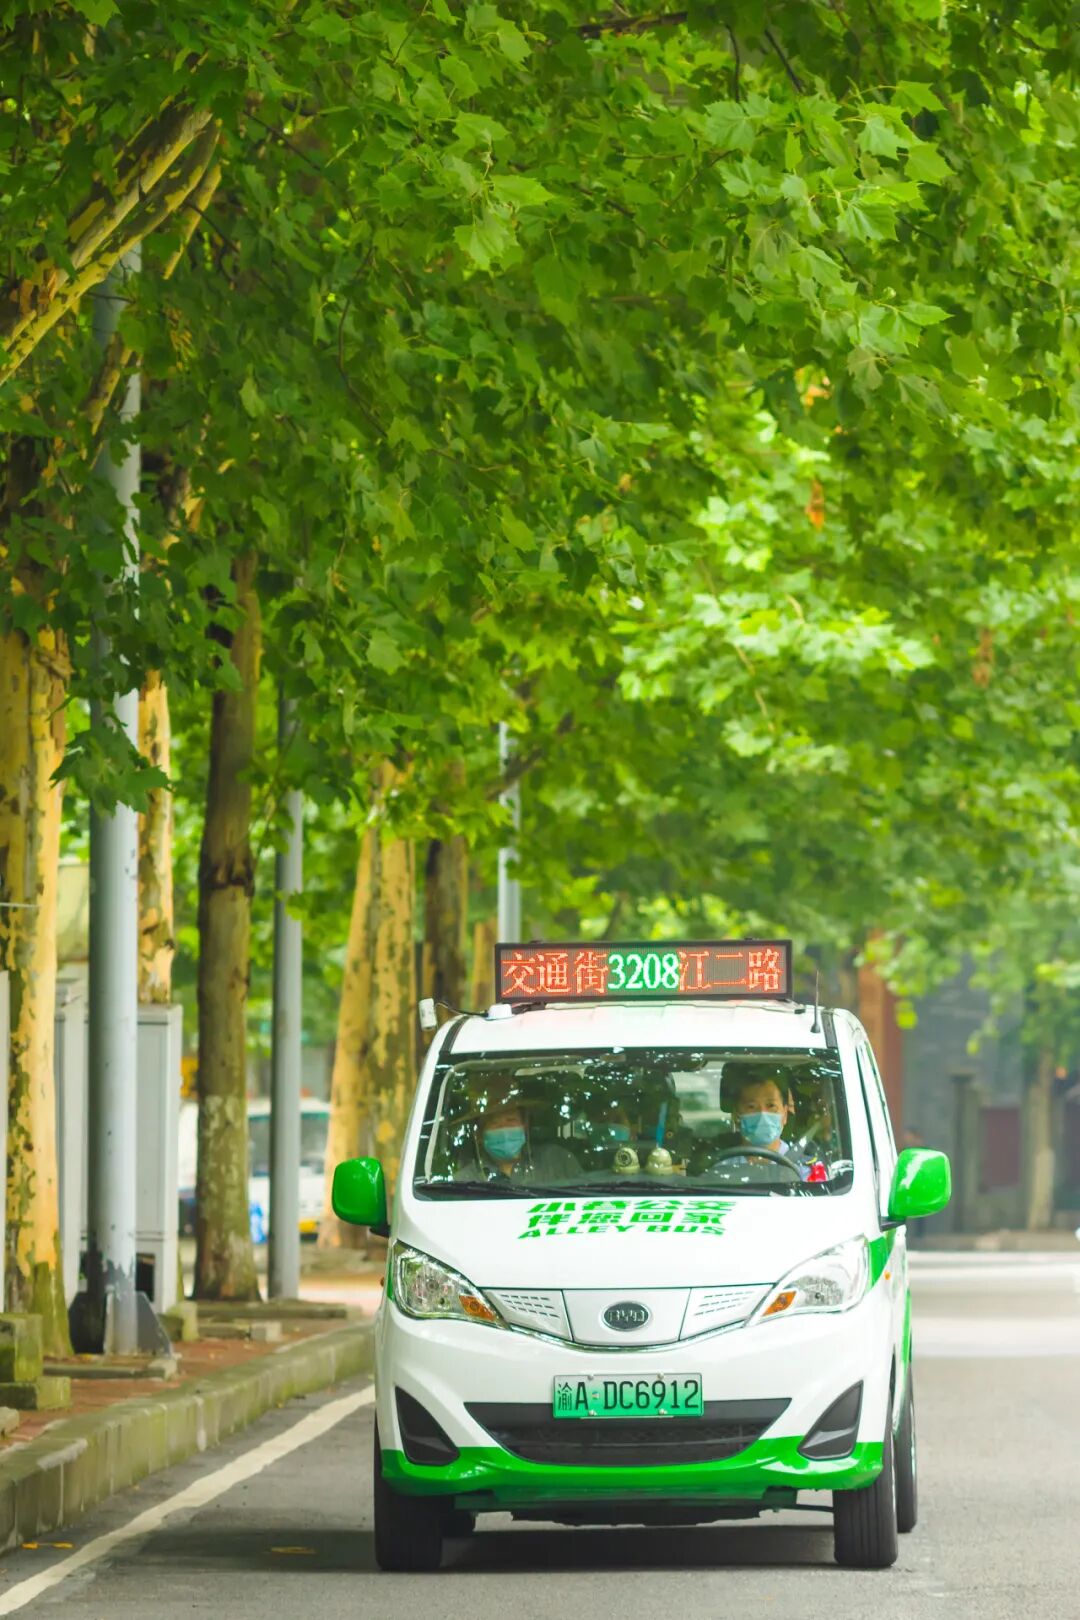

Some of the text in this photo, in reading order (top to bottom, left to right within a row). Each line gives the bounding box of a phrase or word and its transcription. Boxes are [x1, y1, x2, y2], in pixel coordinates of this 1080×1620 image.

[501, 948, 783, 995] 交通街 3208 江二路
[517, 1224, 727, 1240] ALLEY BUS
[527, 1212, 727, 1229] 伴您回家
[603, 1379, 700, 1411] DC6912
